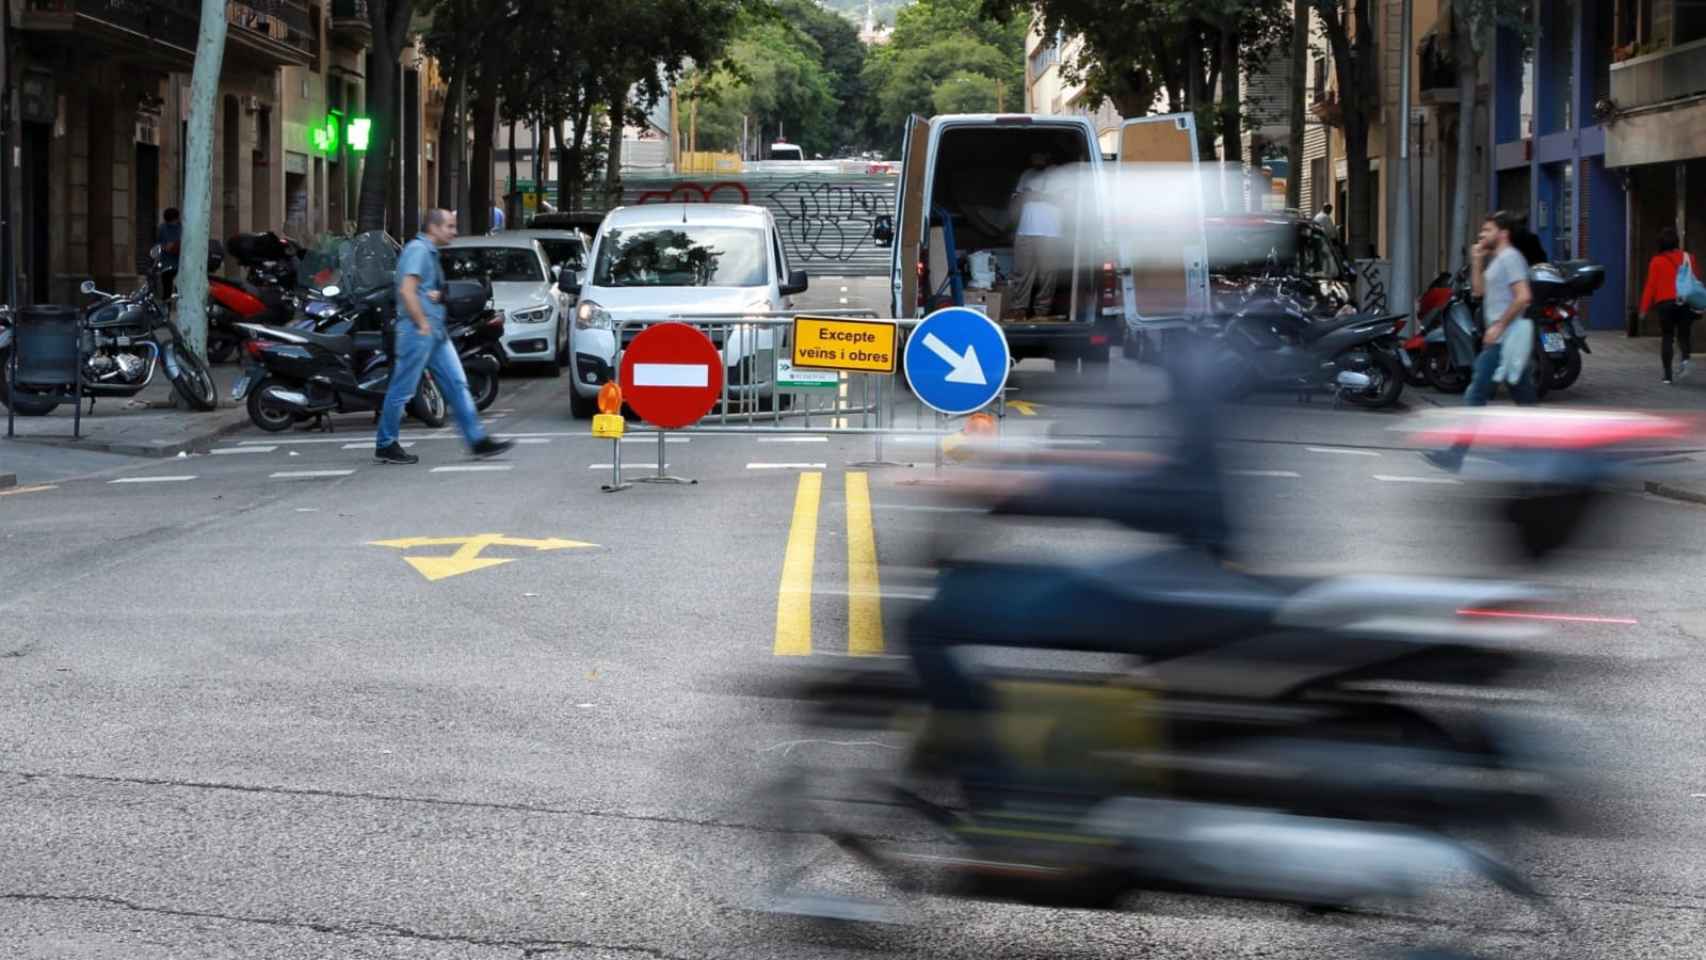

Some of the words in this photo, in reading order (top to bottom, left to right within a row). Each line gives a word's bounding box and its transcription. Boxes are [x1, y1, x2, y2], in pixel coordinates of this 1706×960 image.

[819, 327, 876, 345] Excepte
[799, 346, 837, 360] veïns
[840, 348, 845, 360] i
[848, 349, 889, 363] obres
